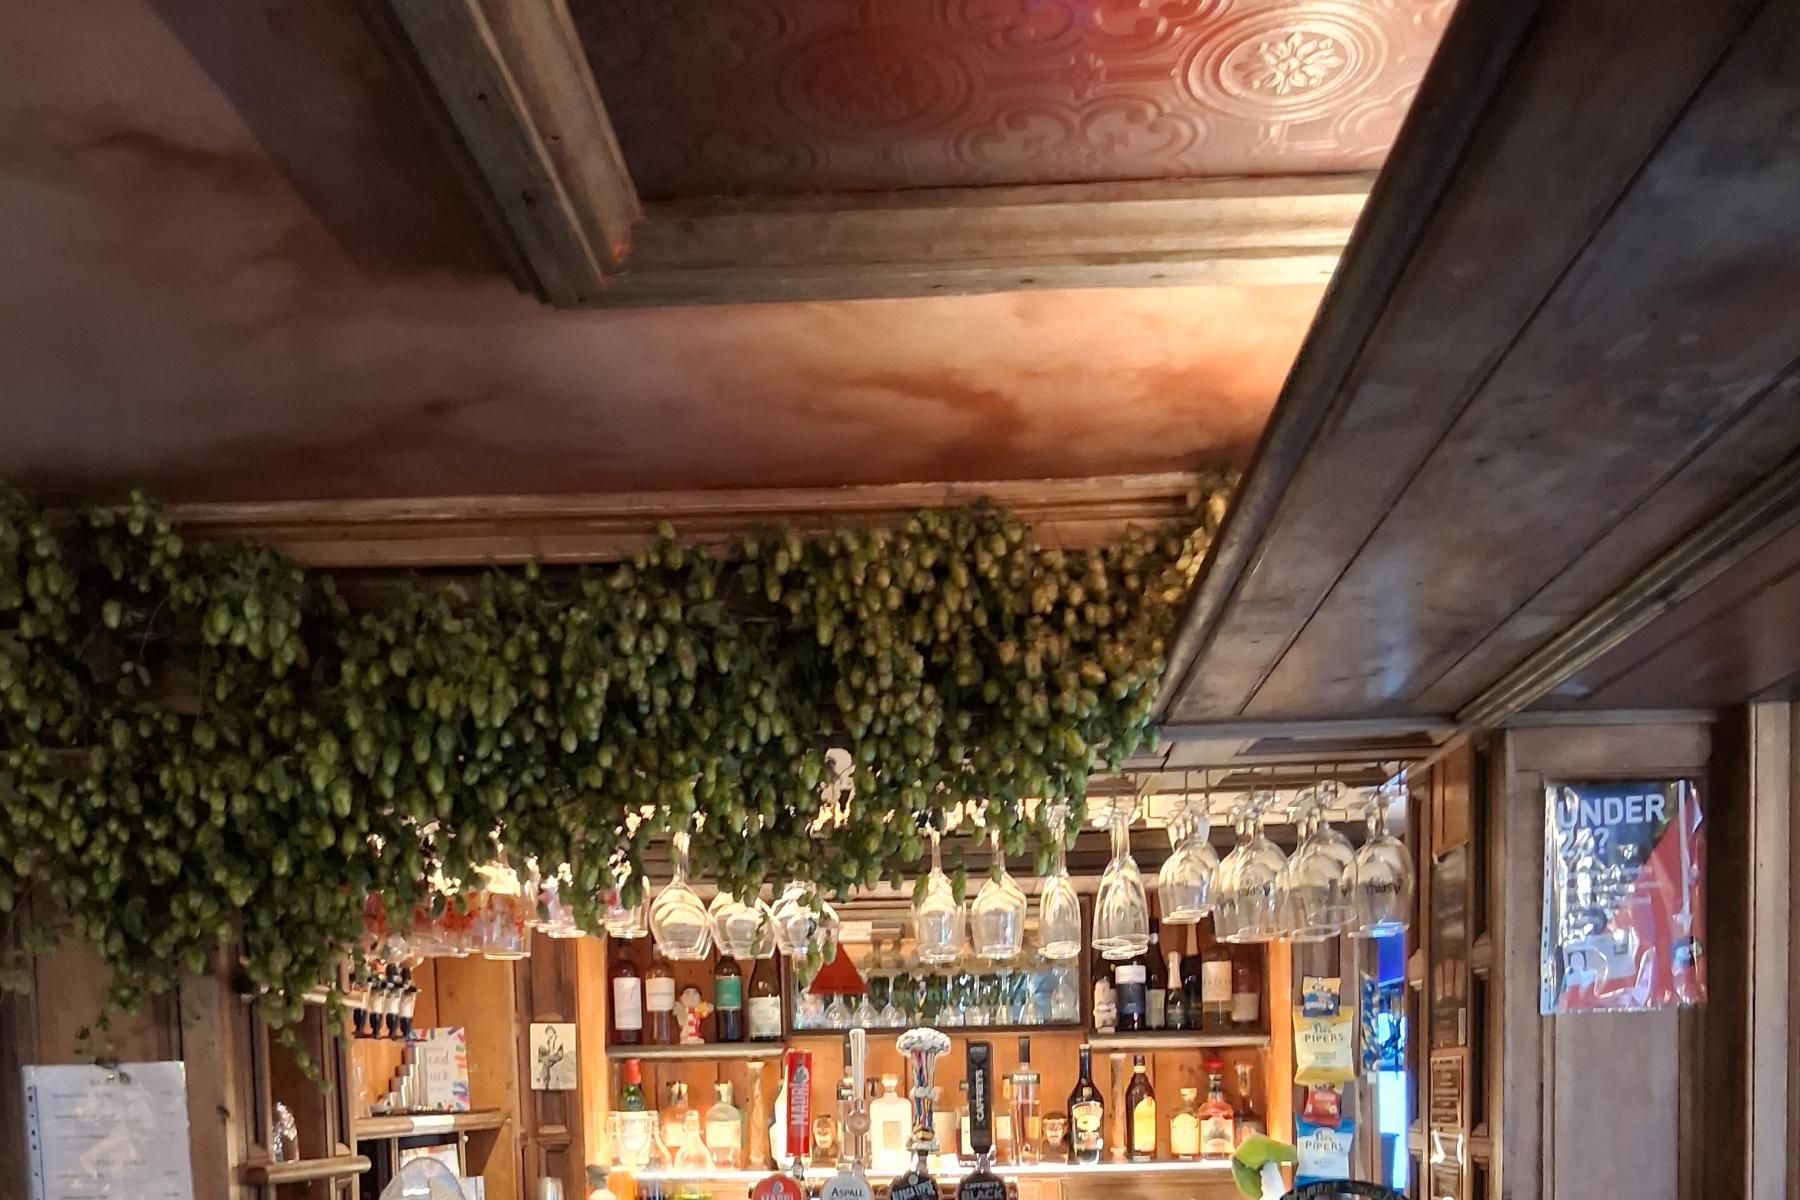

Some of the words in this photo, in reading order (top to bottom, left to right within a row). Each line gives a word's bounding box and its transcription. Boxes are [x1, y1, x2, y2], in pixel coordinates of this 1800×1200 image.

[1557, 793, 1666, 828] UNDER
[1304, 1033, 1344, 1044] PIPERS
[1305, 1140, 1344, 1152] PIPERS
